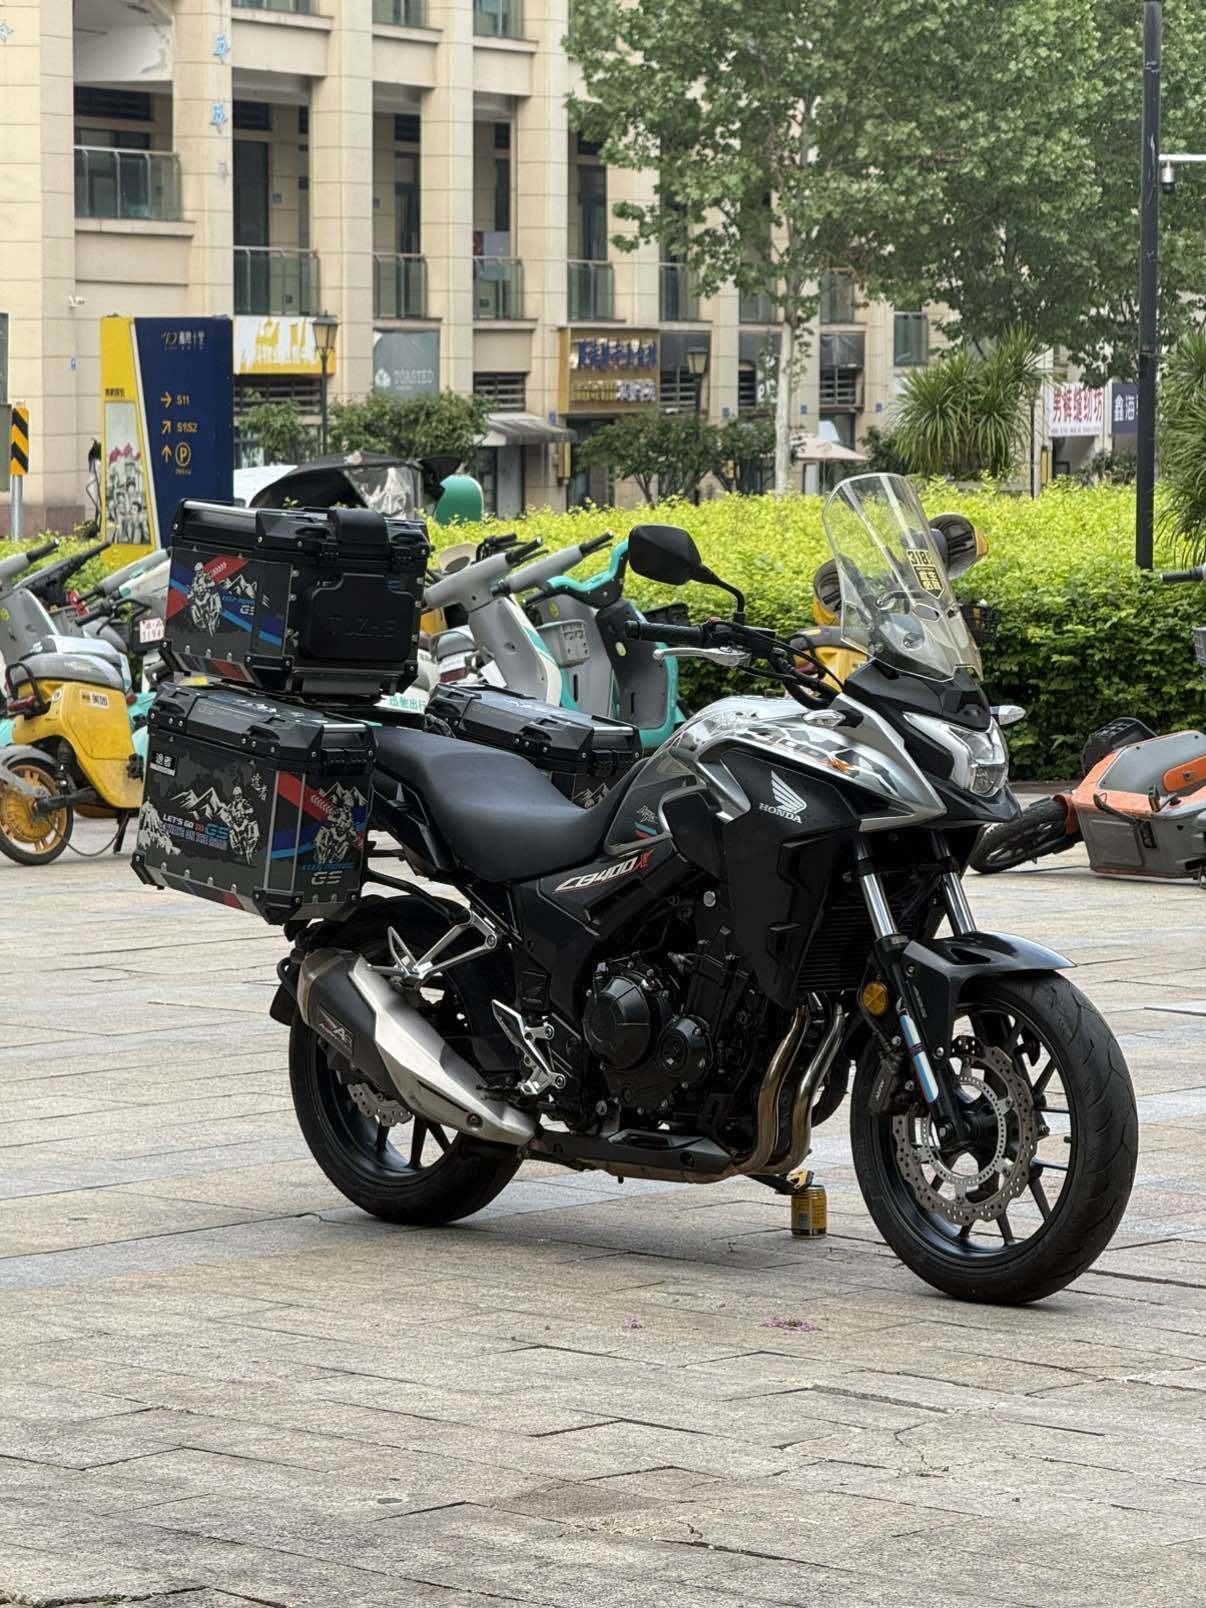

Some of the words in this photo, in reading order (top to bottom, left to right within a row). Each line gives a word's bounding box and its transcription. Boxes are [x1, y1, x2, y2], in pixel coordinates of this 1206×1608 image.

[759, 802, 803, 824] HONDA
[162, 813, 184, 826] LET'S
[183, 819, 195, 829] GO
[204, 823, 229, 840] GS
[311, 870, 343, 886] GS
[554, 848, 655, 891] CB400X
